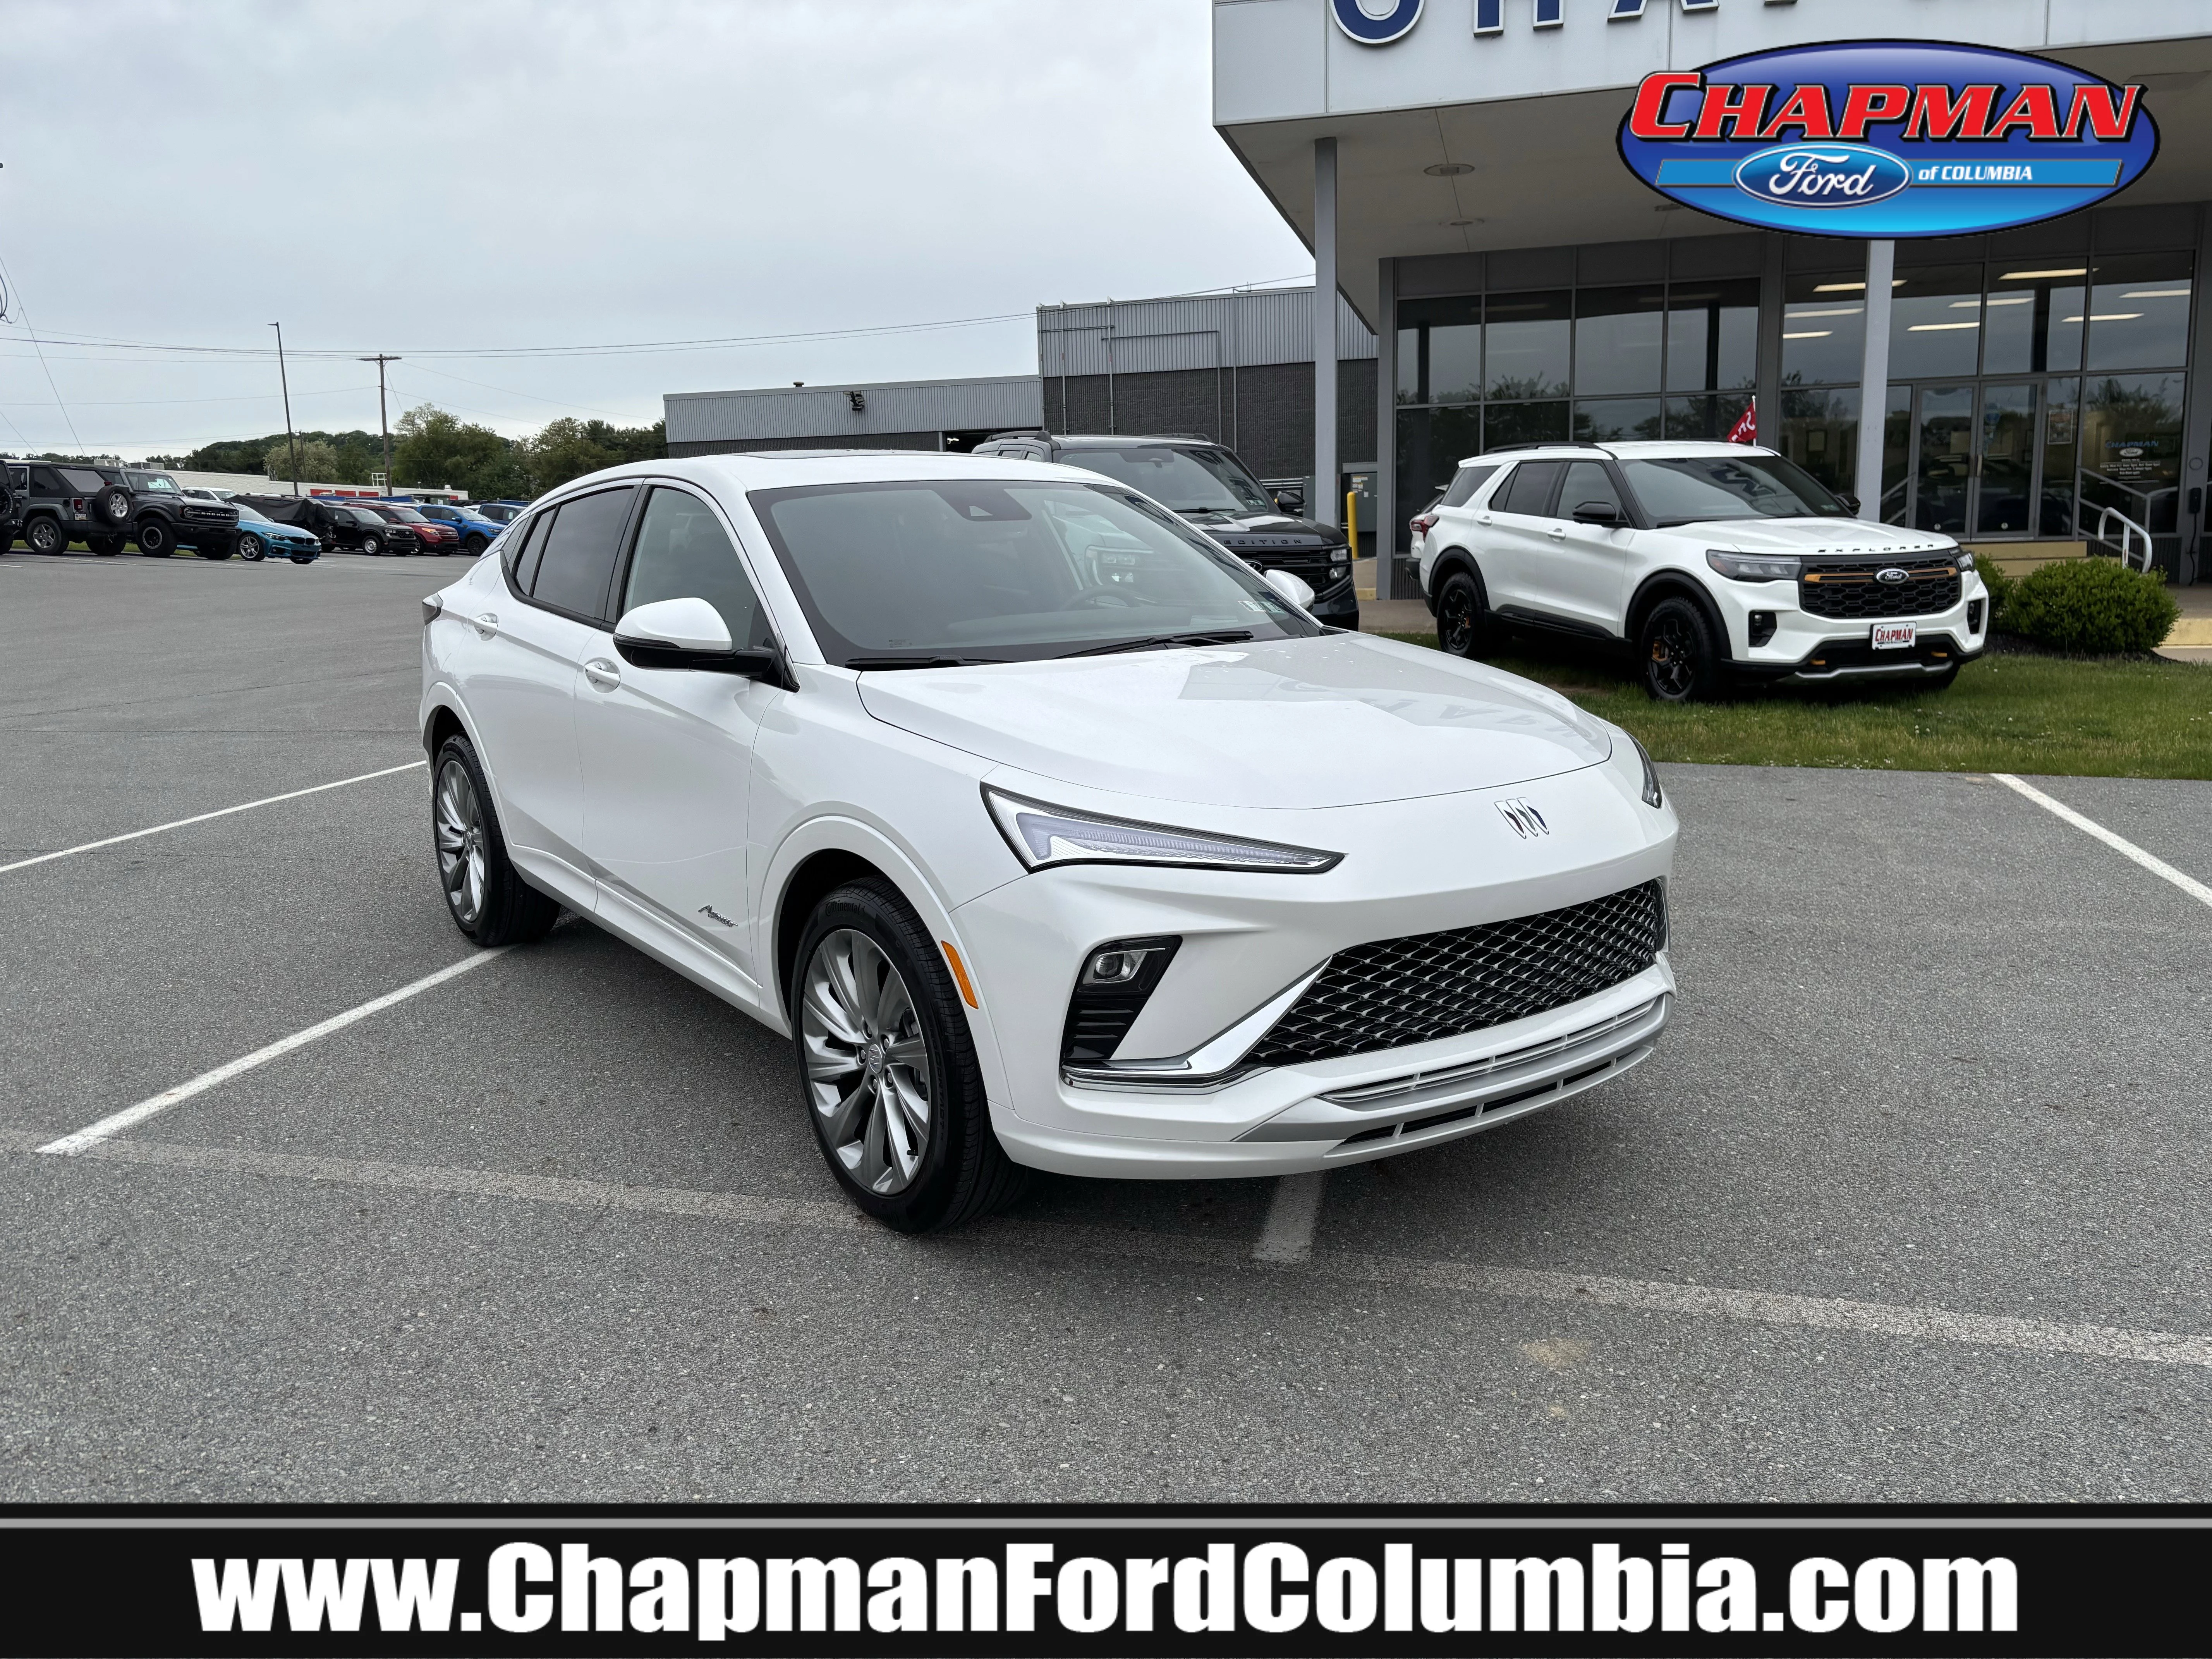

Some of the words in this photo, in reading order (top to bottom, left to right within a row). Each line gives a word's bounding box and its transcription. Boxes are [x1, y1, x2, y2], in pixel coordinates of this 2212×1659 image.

[1817, 543, 1934, 553] EXPLORER
[1875, 628, 1913, 642] CHAPMAN
[825, 899, 860, 916] Continental
